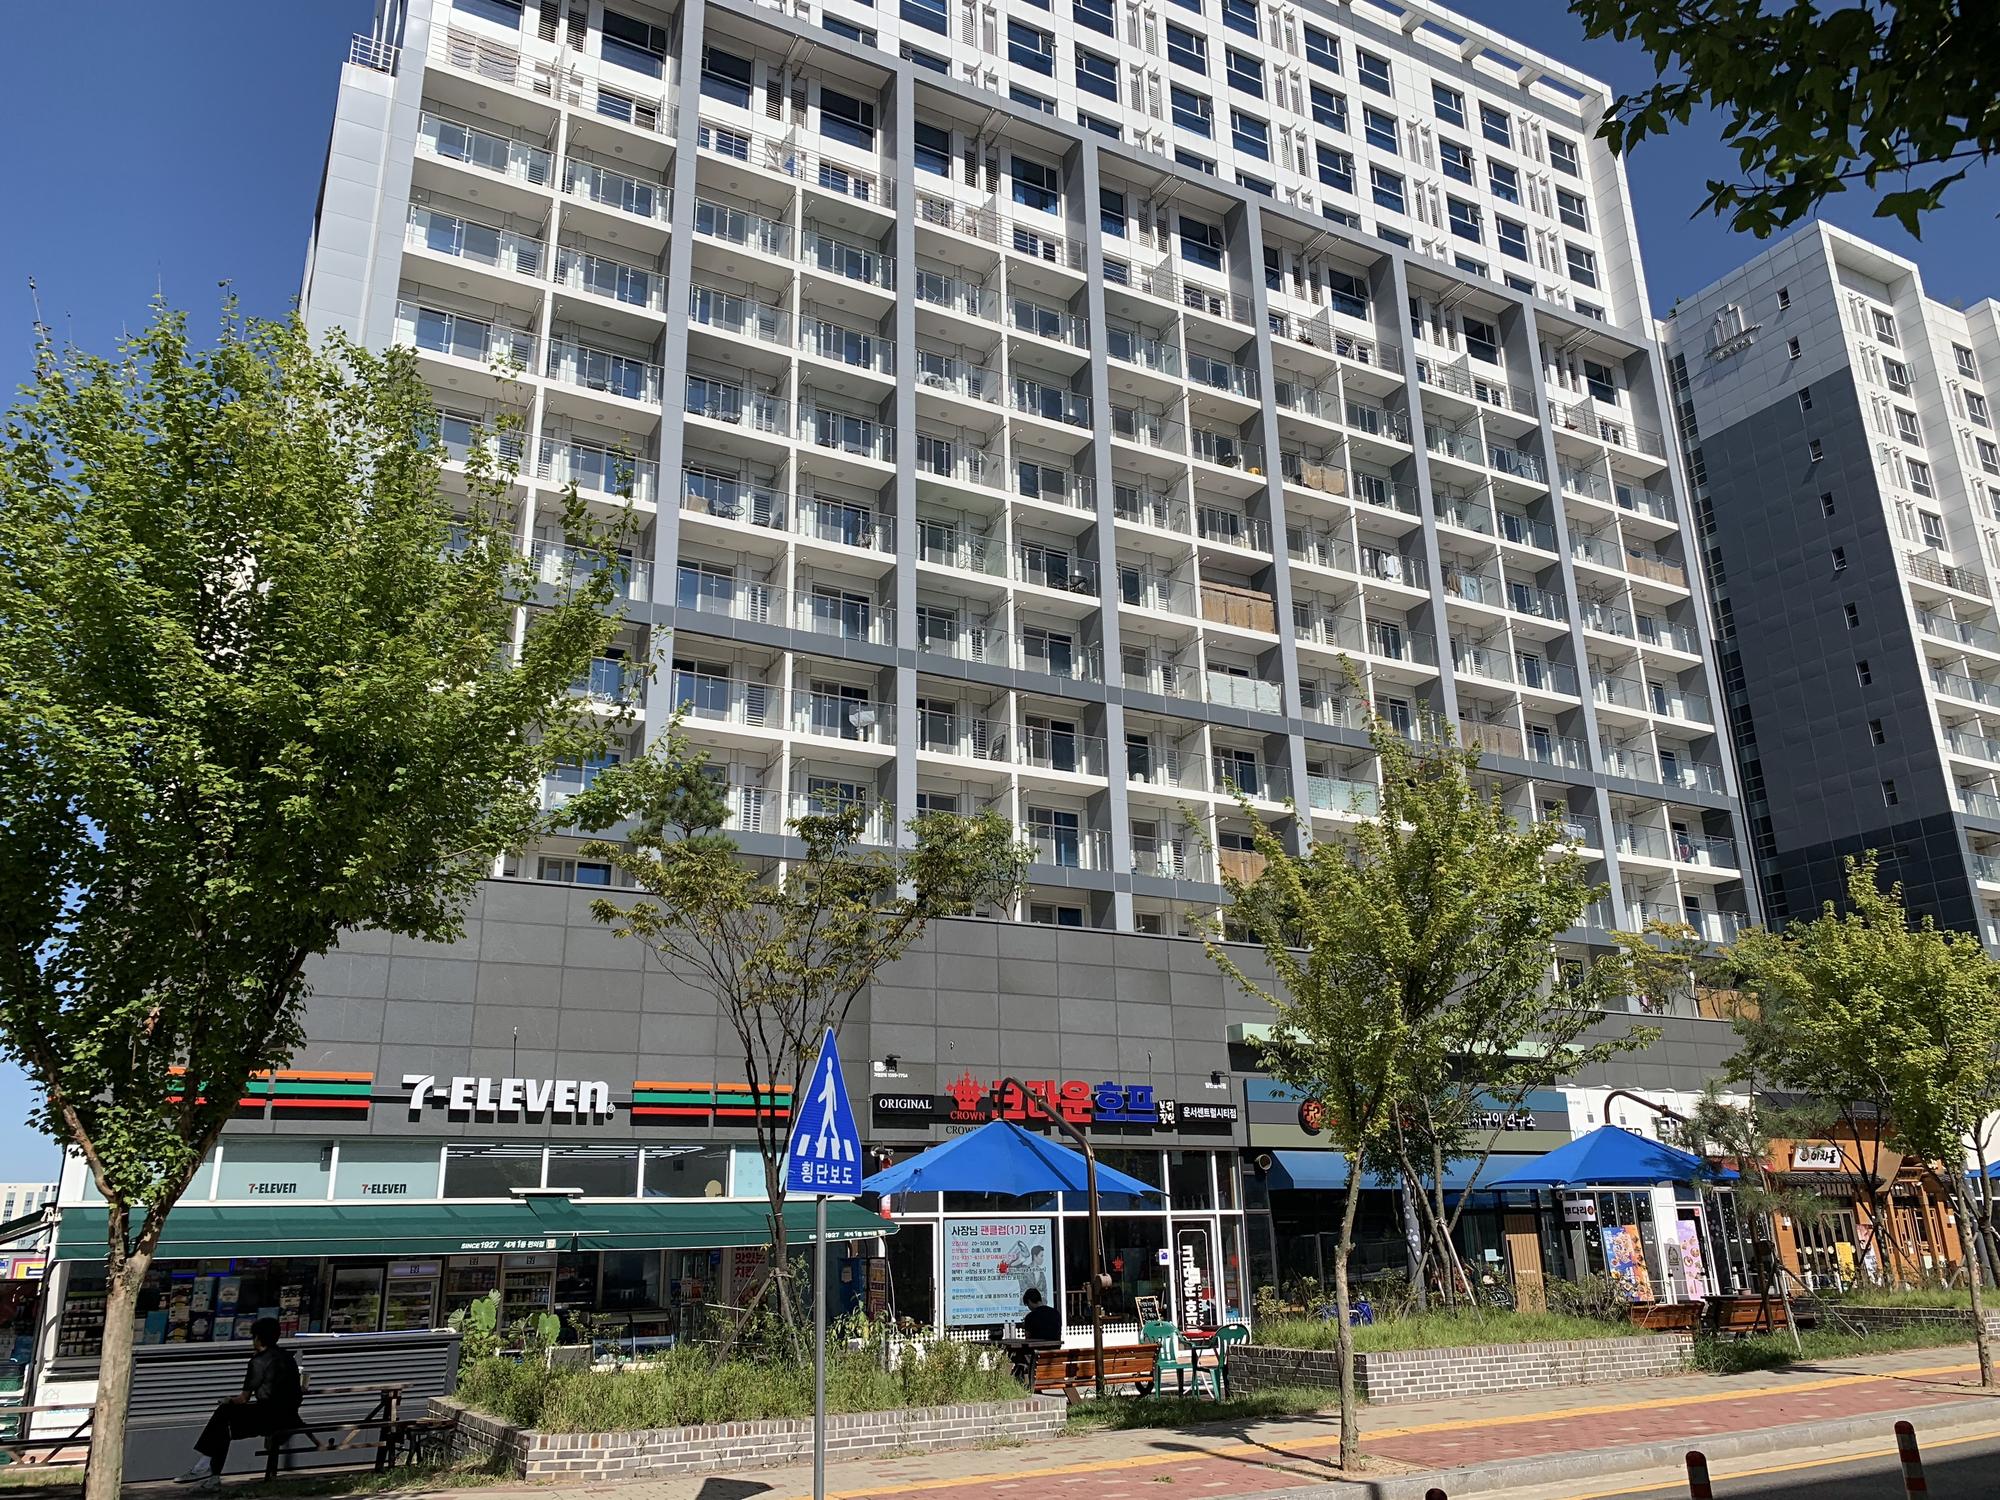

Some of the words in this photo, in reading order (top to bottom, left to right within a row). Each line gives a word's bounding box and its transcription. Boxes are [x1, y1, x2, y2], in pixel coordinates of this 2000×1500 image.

[879, 1098, 933, 1110] ORIGINAL
[1159, 1101, 1175, 1113] 보리
[950, 1111, 986, 1120] CROWN
[1159, 1113, 1176, 1124] 장인
[1183, 1106, 1237, 1119] 운서센트럴시티점
[1811, 1150, 1836, 1164] 이차돌
[801, 1161, 853, 1185] 횡단보도
[951, 1225, 978, 1236] 사장님
[1029, 1224, 1046, 1235] 모집
[460, 1242, 480, 1250] SINCE
[480, 1240, 500, 1249] 1927
[735, 1252, 766, 1265] 맛있는
